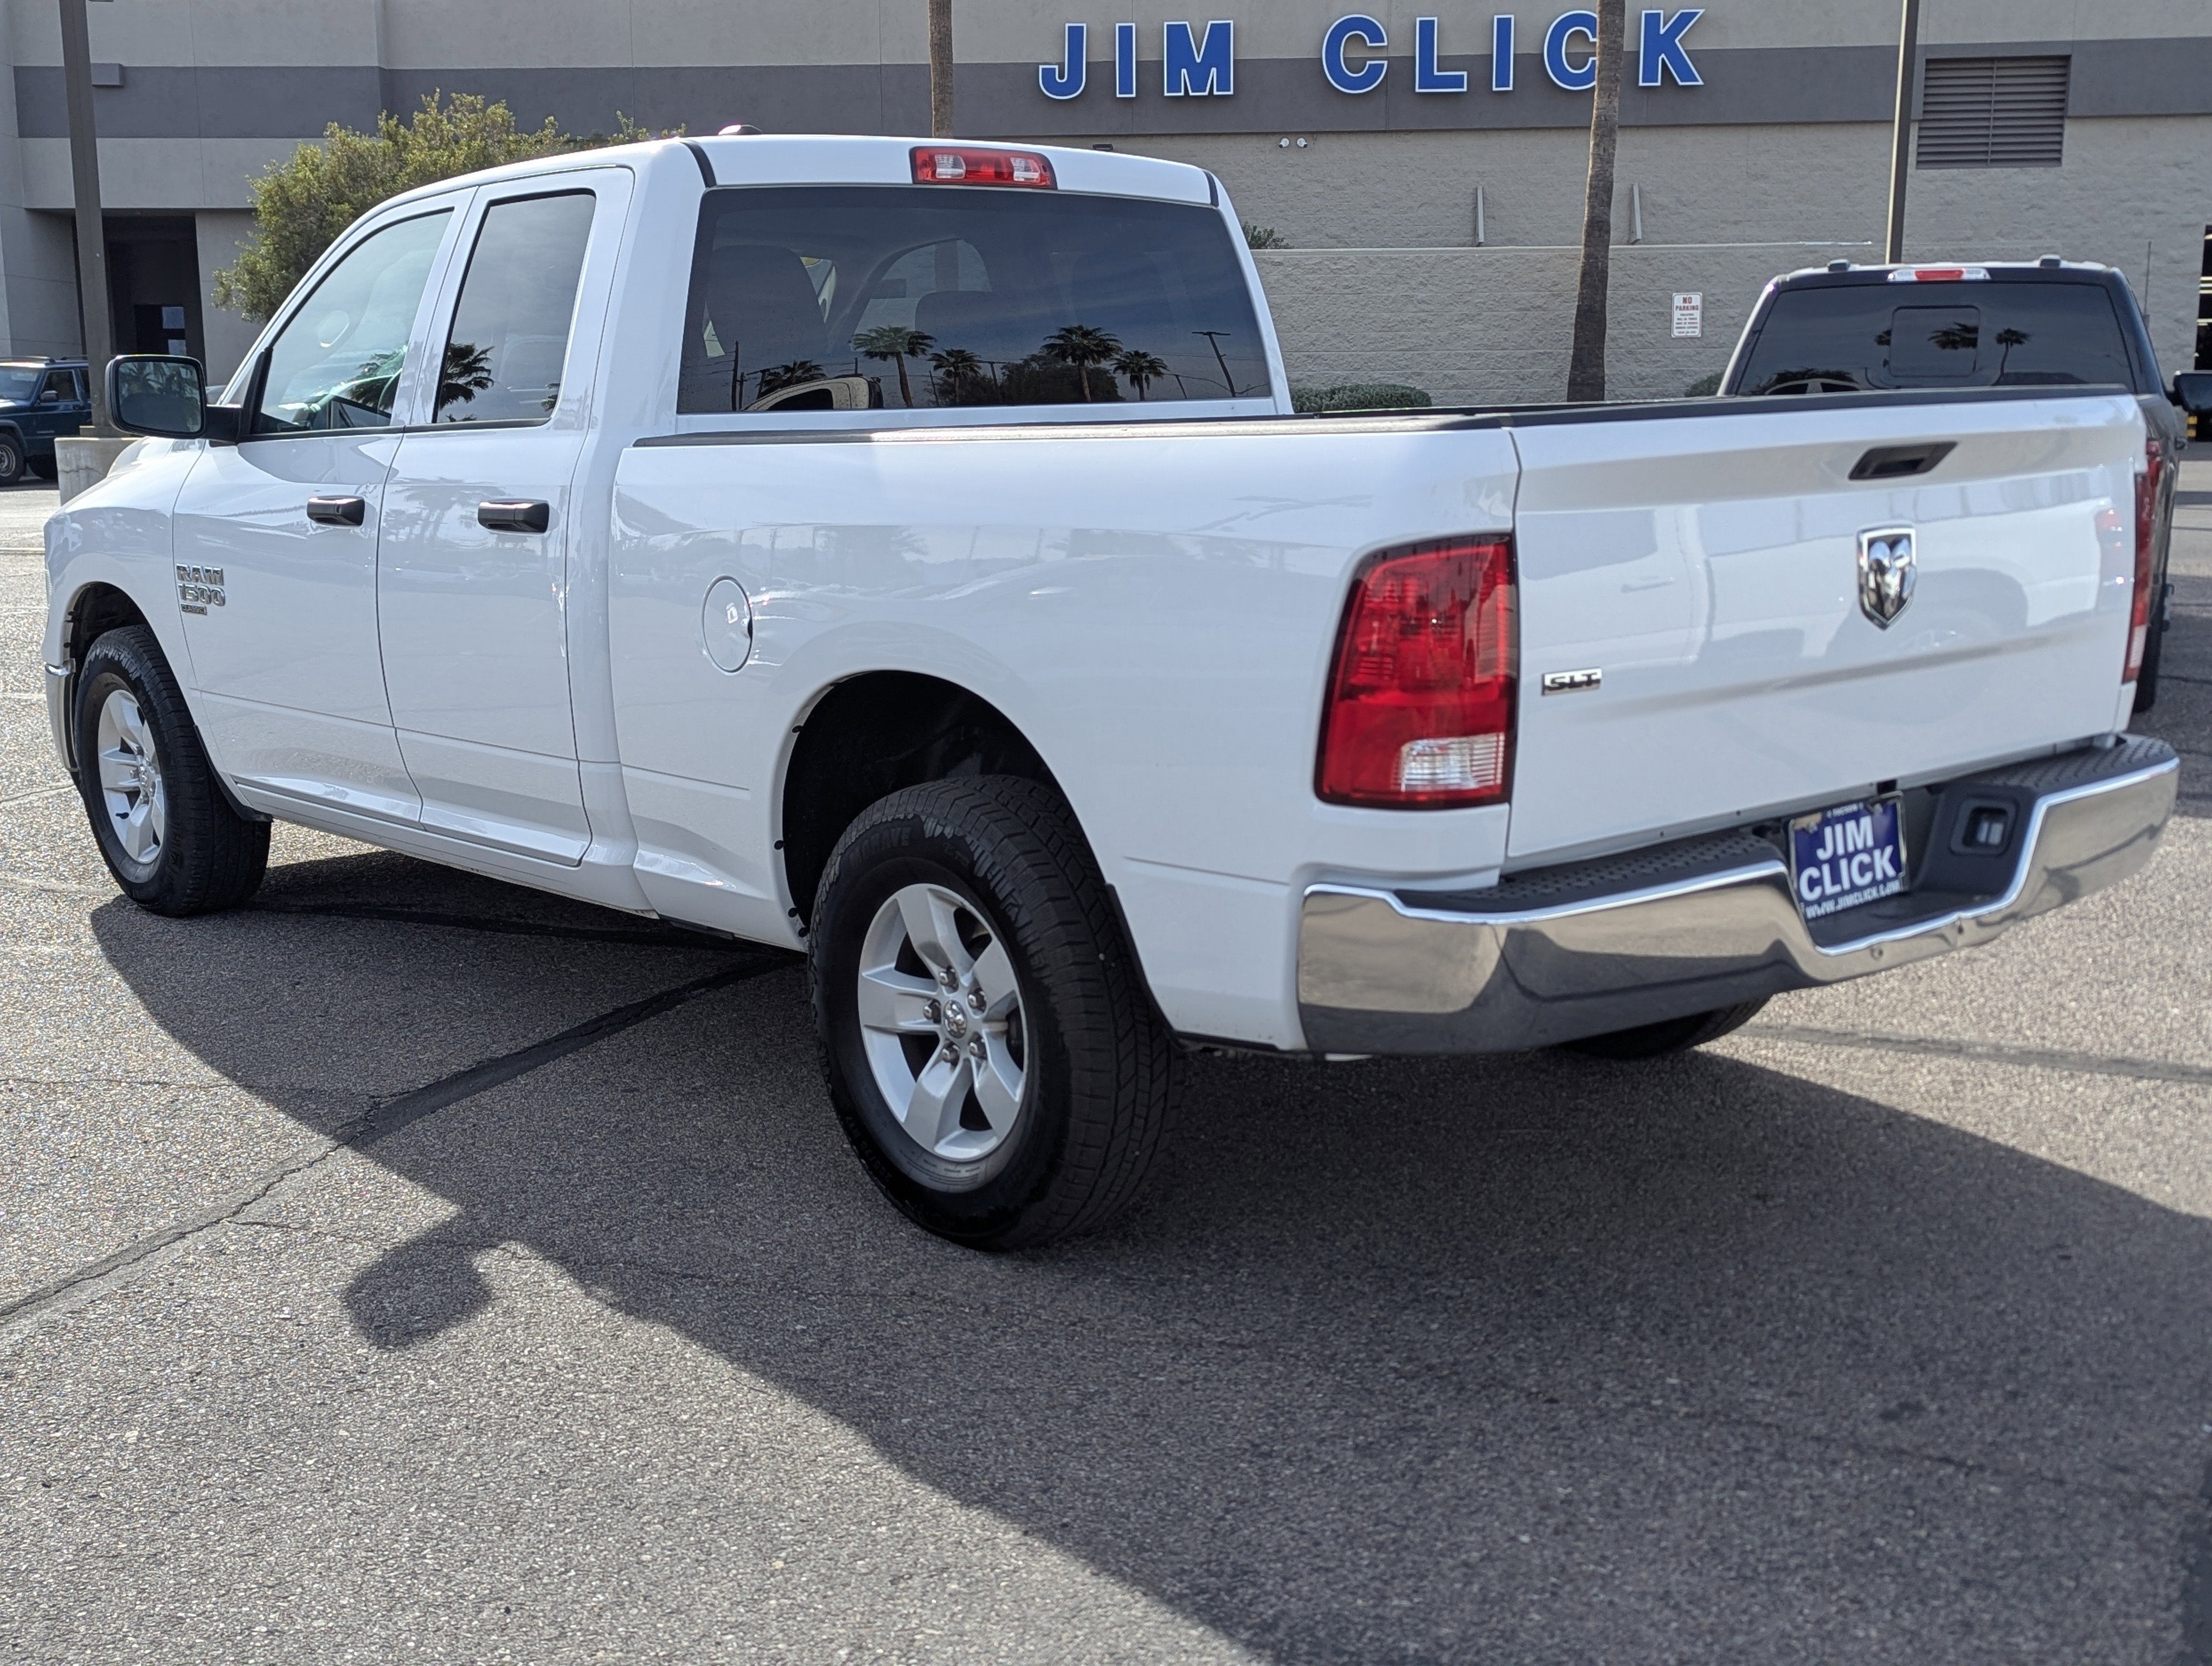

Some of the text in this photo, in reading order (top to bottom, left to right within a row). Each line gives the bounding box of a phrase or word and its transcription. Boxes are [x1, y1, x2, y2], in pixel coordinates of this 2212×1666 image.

[1038, 8, 1705, 100] JIM CLICK
[176, 563, 224, 586] RAM
[178, 584, 226, 607] 1500
[1546, 670, 1600, 692] SLT
[1816, 815, 1874, 861] JIM
[1799, 844, 1896, 901] CLICK
